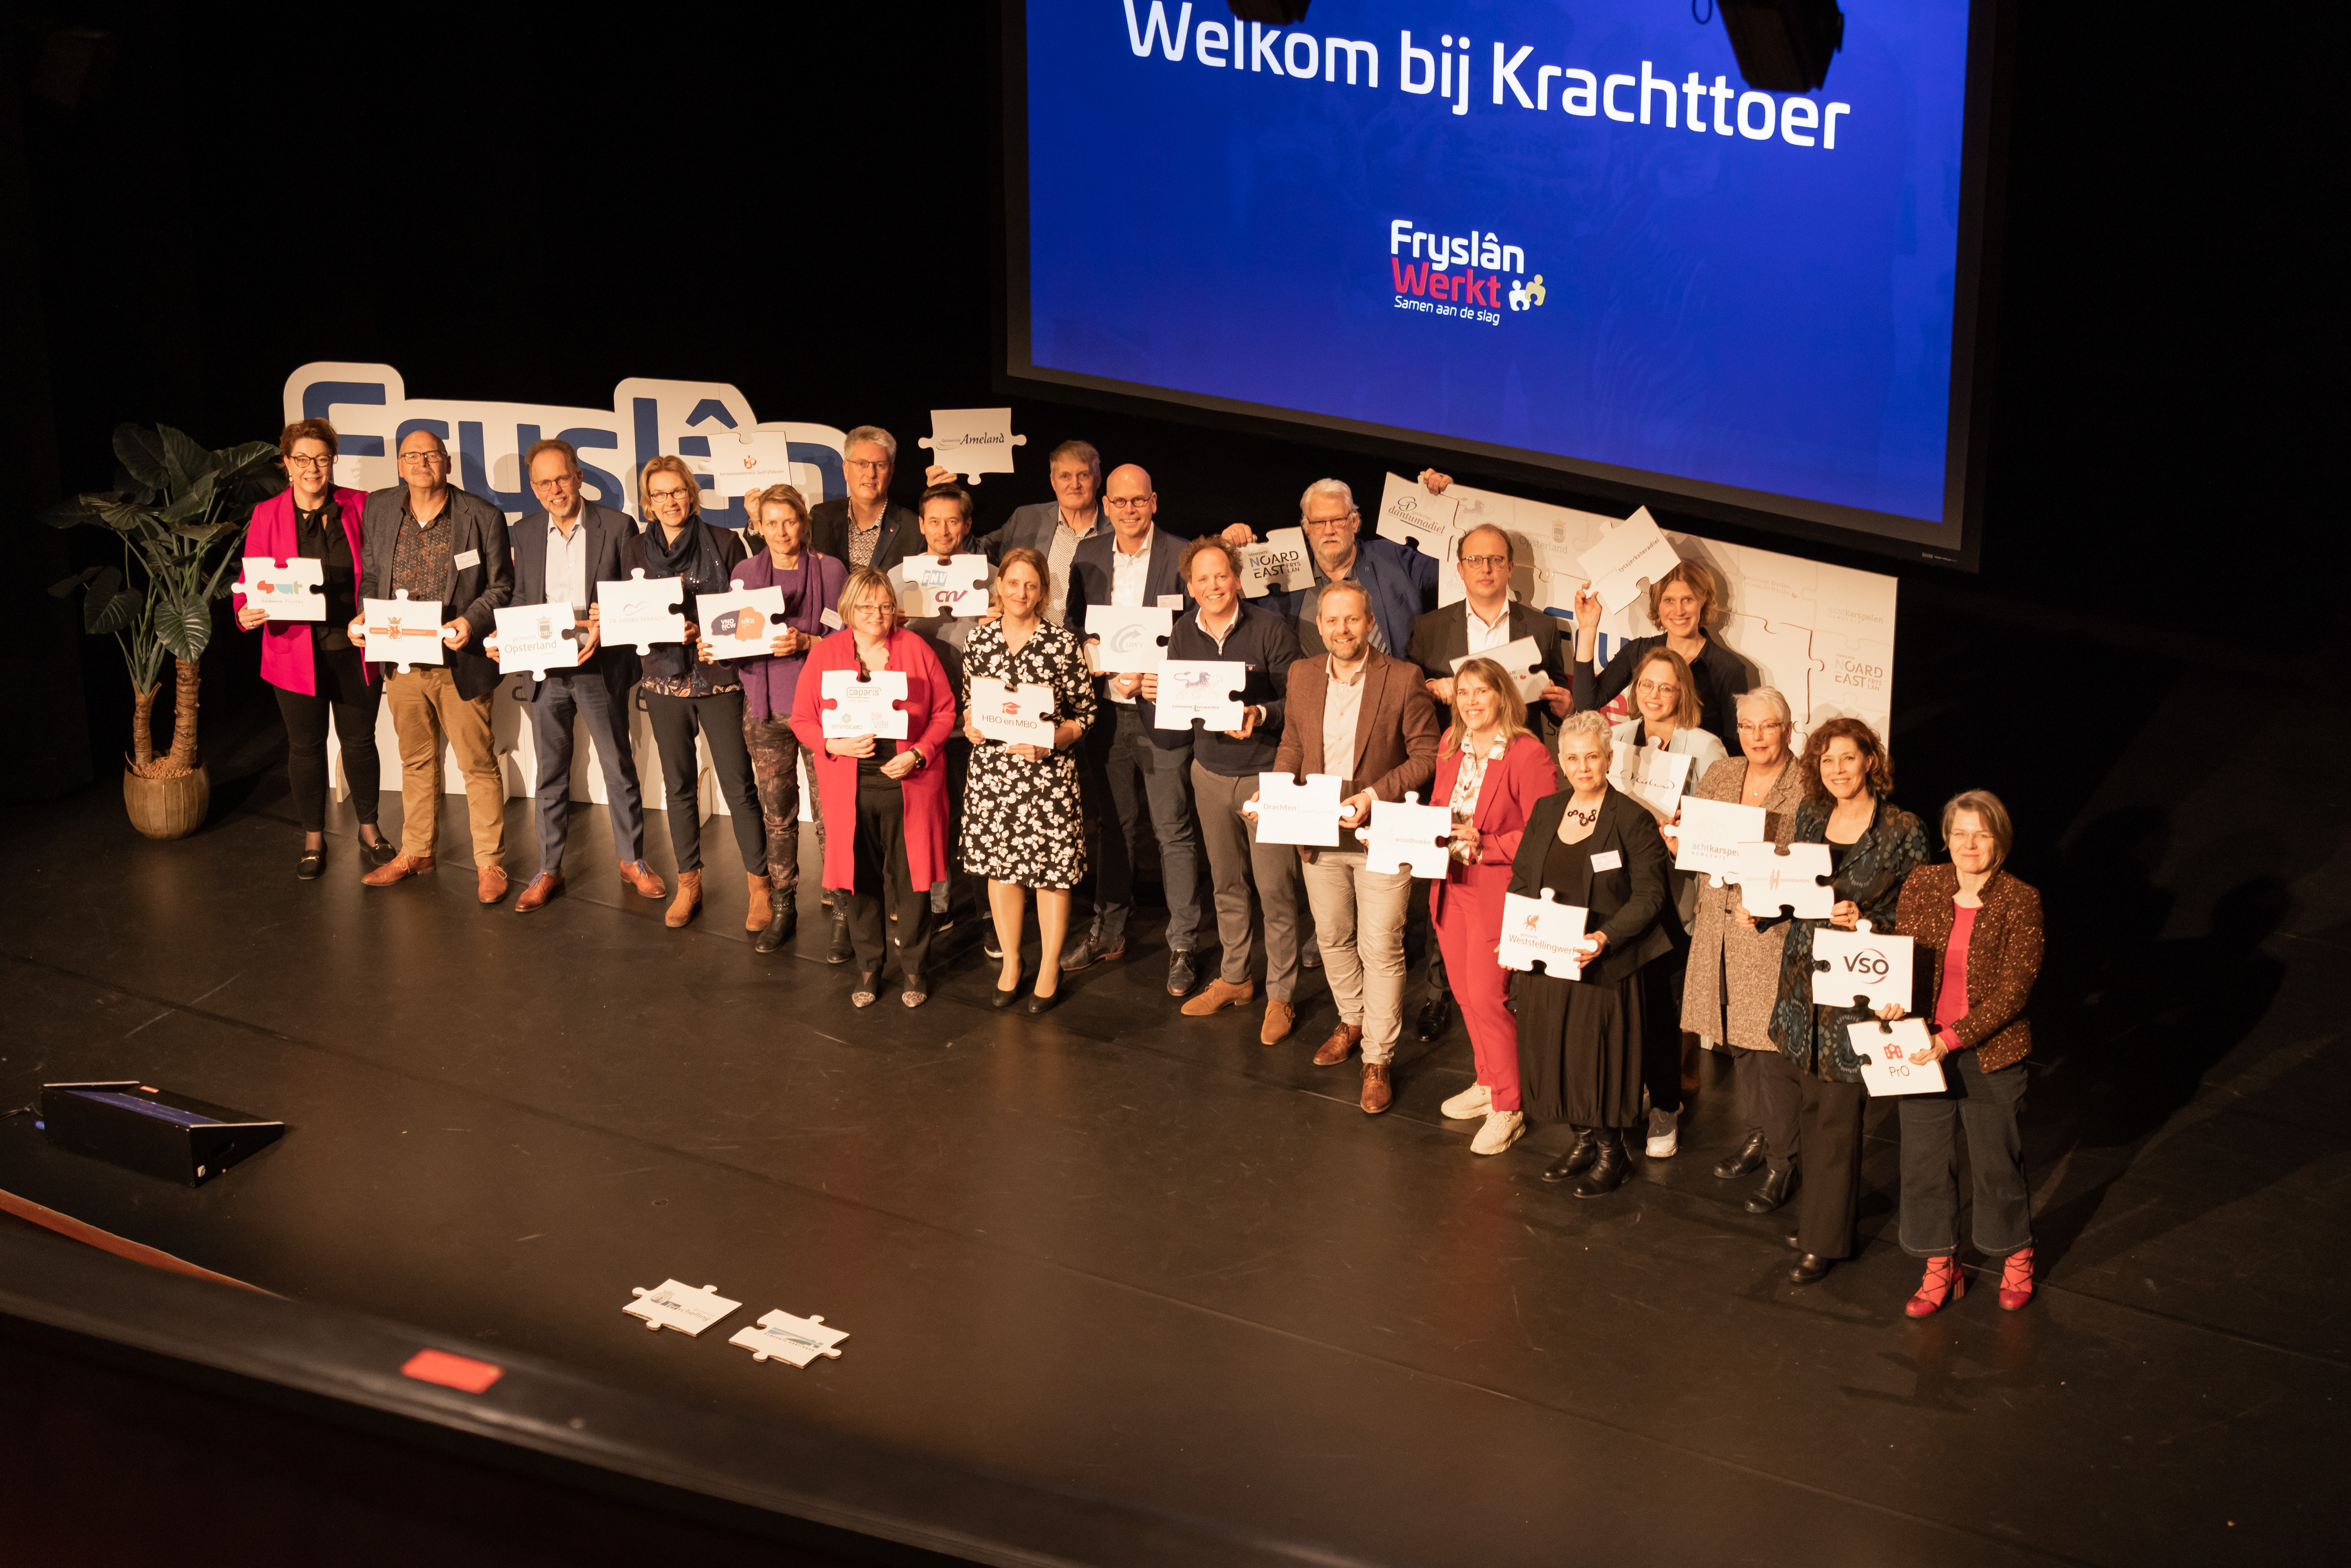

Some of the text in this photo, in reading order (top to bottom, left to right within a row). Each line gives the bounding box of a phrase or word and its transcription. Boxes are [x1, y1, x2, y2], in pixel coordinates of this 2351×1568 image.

[1123, 0, 1851, 150] Welkom bij Krachttoer
[1391, 219, 1524, 274] Fryslân
[1391, 257, 1501, 308] Werkt
[1394, 295, 1500, 326] Samen aan de slag
[960, 432, 1004, 445] Ameland
[1388, 506, 1446, 534] dantumadiel
[1519, 536, 1567, 554] Opsterland
[1249, 551, 1299, 568] NOARD
[1618, 537, 1660, 573] tytsjerksteradiel
[922, 572, 948, 585] FNV
[1253, 564, 1284, 579] EAST
[505, 640, 557, 655] Opsterland
[512, 635, 537, 643] gemeente
[982, 714, 1002, 724] HBO
[1016, 719, 1037, 729] MBO
[1263, 803, 1297, 811] Drachten
[1691, 851, 1726, 861] GEMEENTE
[1509, 934, 1576, 955] Weststellingwerf
[1843, 951, 1889, 975] VSO
[1888, 1065, 1910, 1077] PrO
